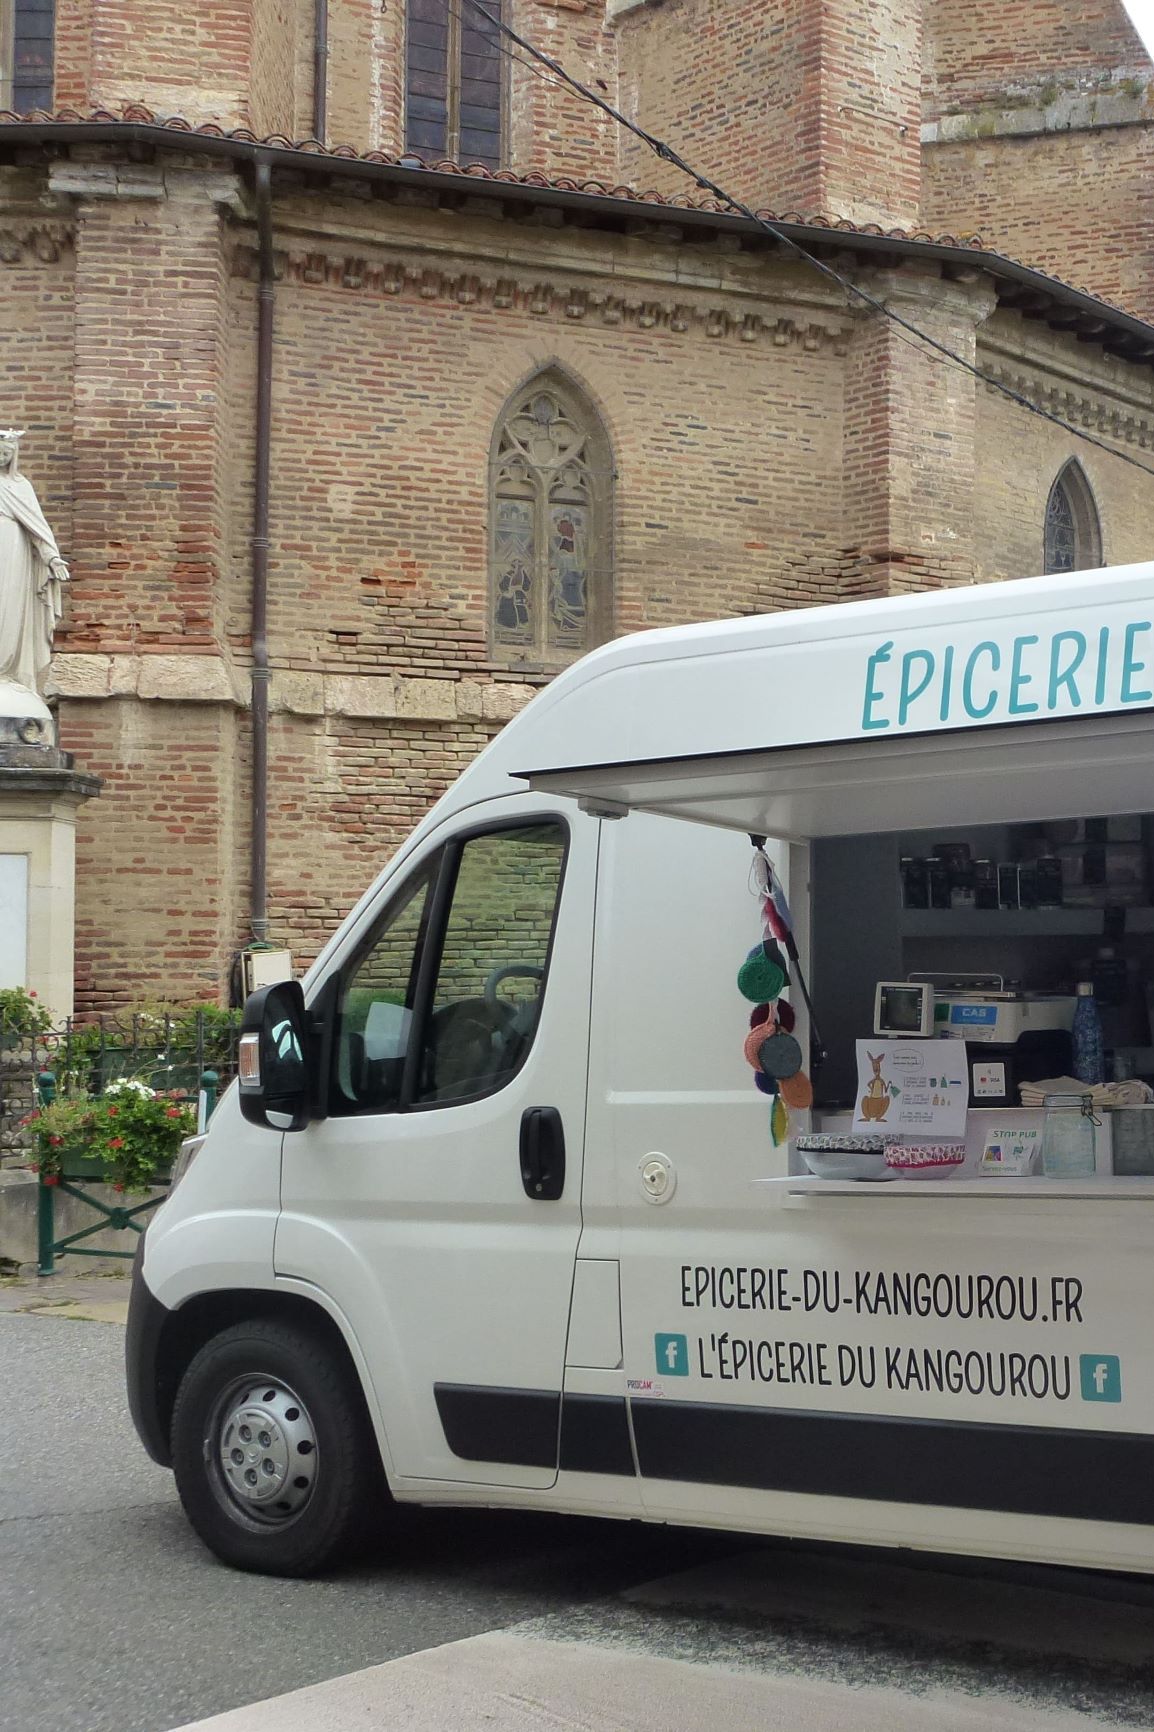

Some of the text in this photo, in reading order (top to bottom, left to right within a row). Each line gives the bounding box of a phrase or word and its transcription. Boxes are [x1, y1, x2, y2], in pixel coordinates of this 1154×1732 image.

[862, 641, 1153, 730] ÉPICERIE
[961, 1007, 987, 1018] CAS
[1019, 1130, 1037, 1138] PUB
[681, 1265, 1083, 1323] EPICERIE-DU-KANGOUROU.FR
[698, 1332, 1070, 1400] L'ÉPICERIE DU KANGOUROU
